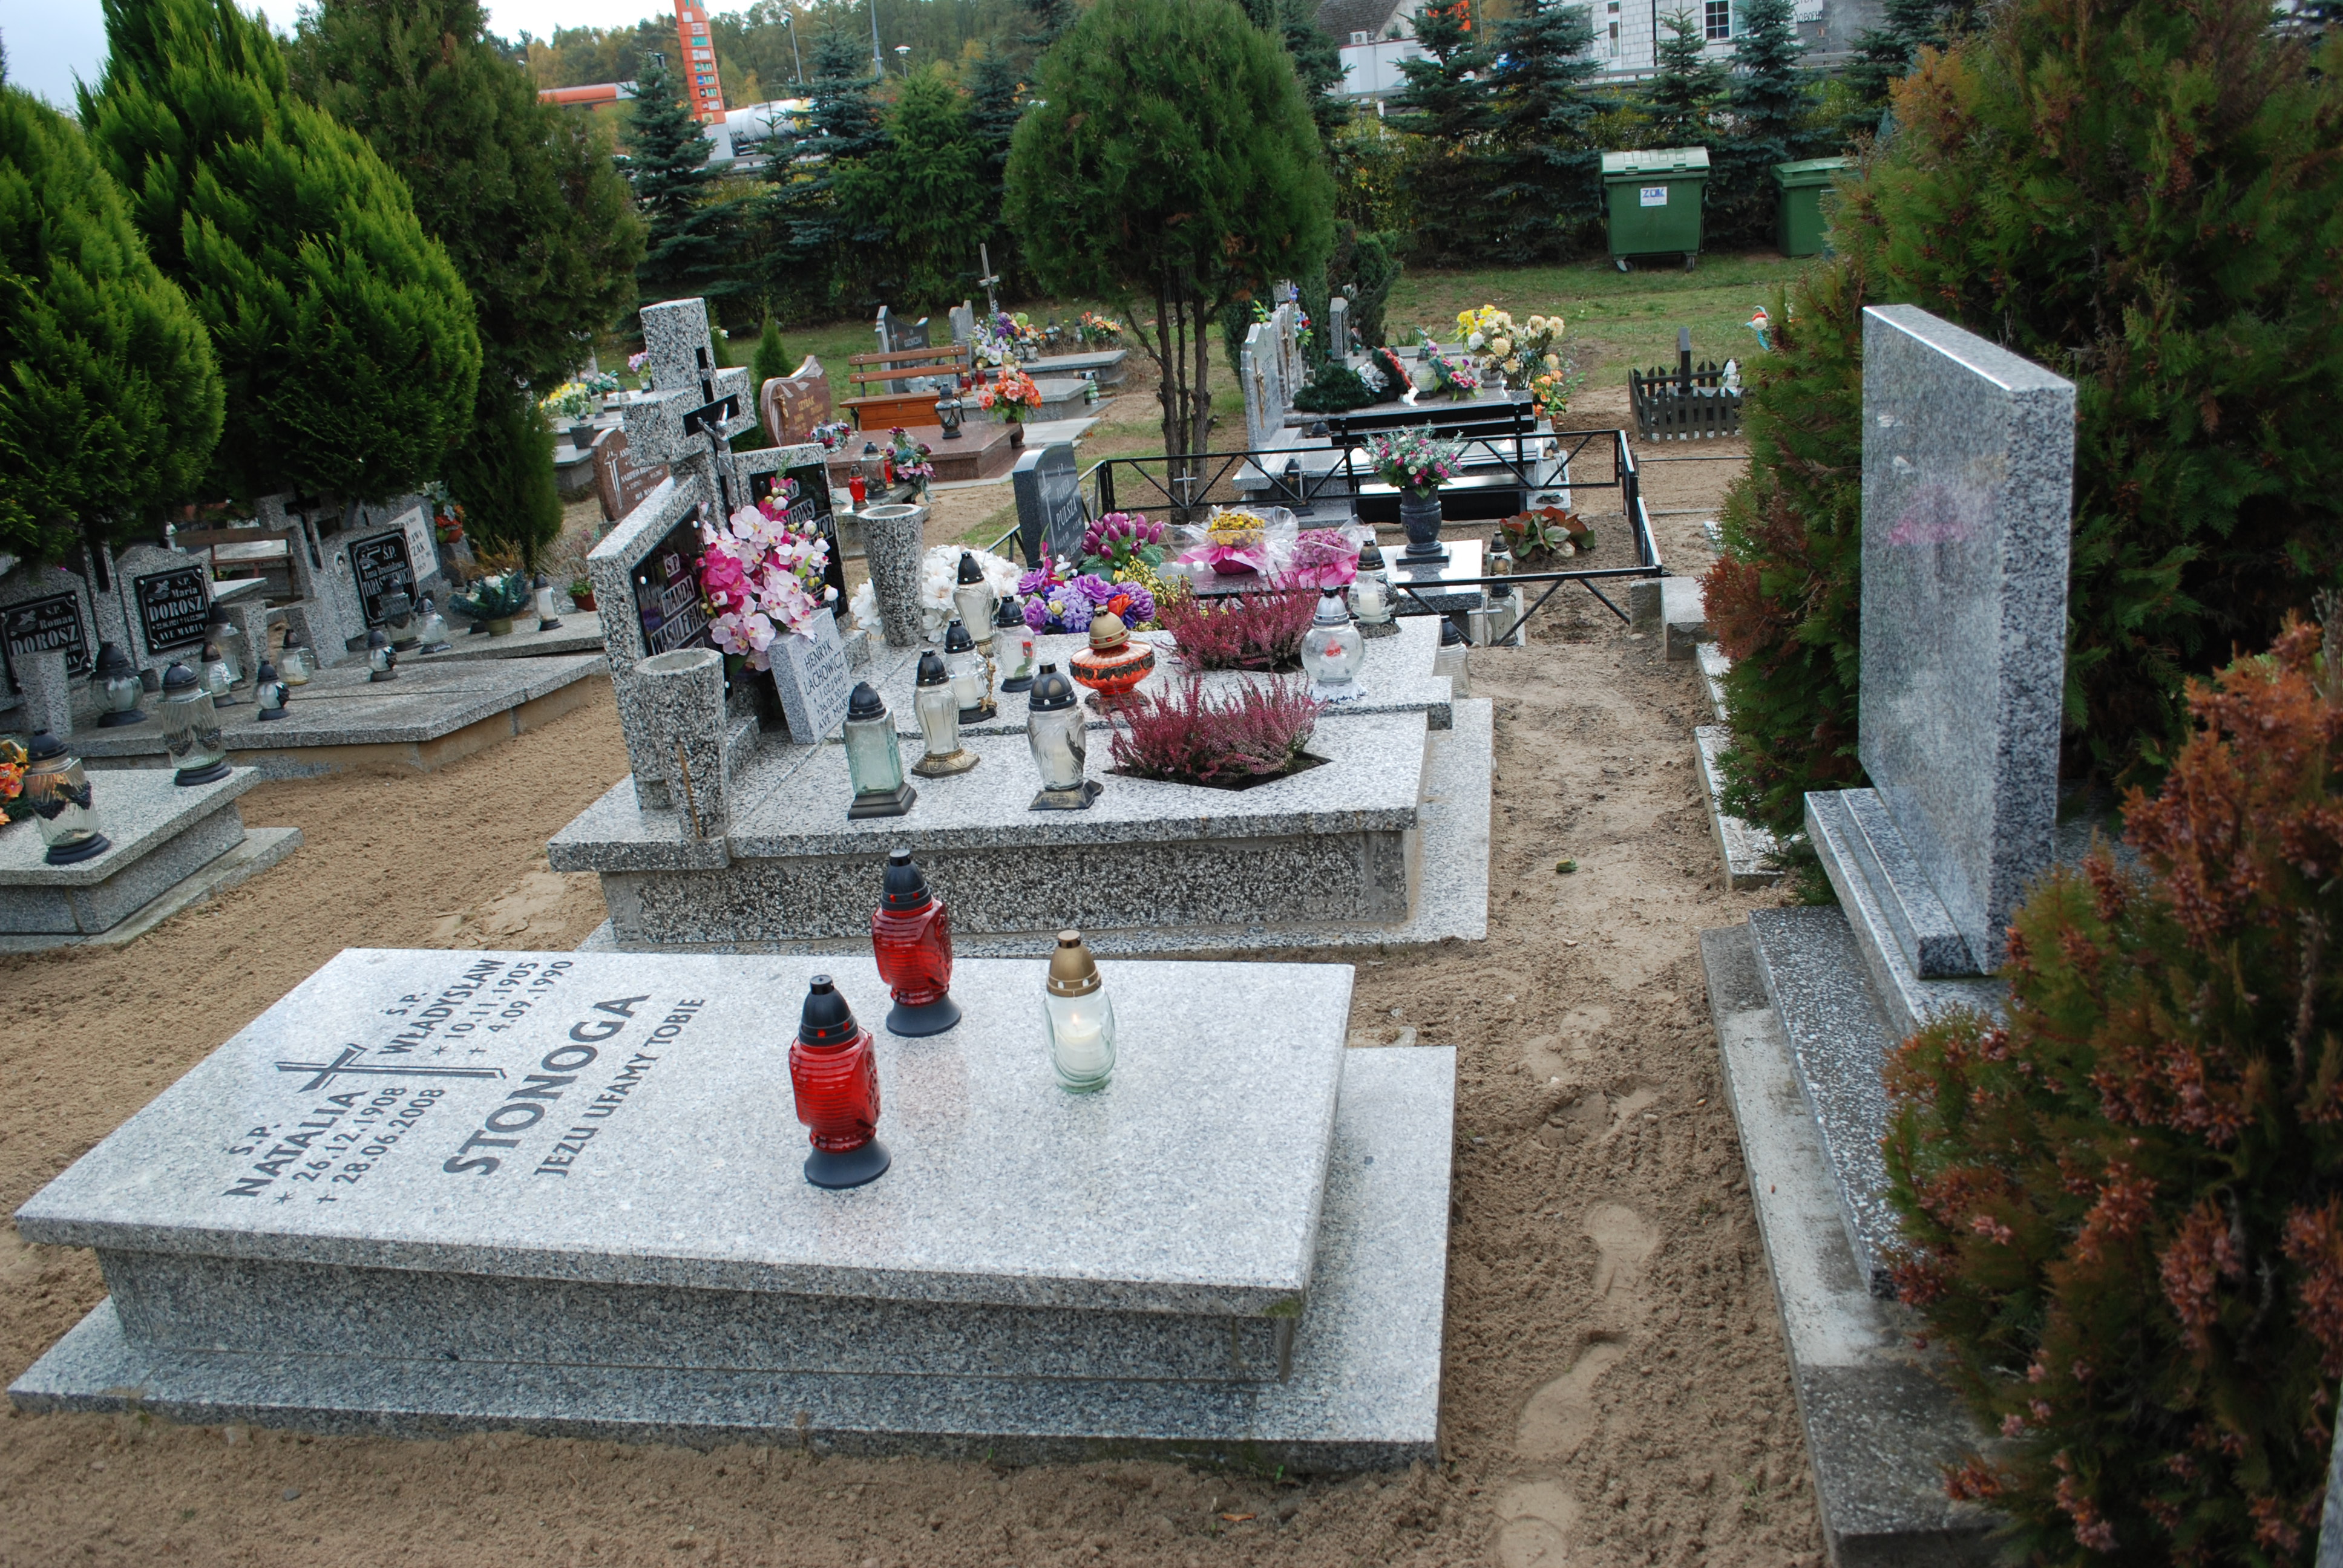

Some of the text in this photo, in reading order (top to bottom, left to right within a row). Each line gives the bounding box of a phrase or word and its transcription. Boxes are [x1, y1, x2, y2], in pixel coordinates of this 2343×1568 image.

[148, 595, 204, 622] DOROSZ
[171, 585, 198, 598] Maria
[10, 625, 79, 656] DOROSZ
[39, 615, 74, 630] Roman
[177, 623, 204, 635] MARIA
[803, 652, 844, 695] LACHOWICZ
[804, 638, 834, 671] HENRYK
[819, 714, 831, 732] AVE
[377, 959, 506, 1055] WŁADYSŁAW
[444, 962, 539, 1039] 10.11.1905
[488, 961, 573, 1033] 4.09.1990
[443, 994, 651, 1175] STONOGA
[533, 999, 707, 1179] JEZU UFAMY TOBIE
[221, 1090, 369, 1197] NATALIA
[292, 1088, 407, 1182] 26.12.1908
[332, 1089, 446, 1184] 28.06.2008
